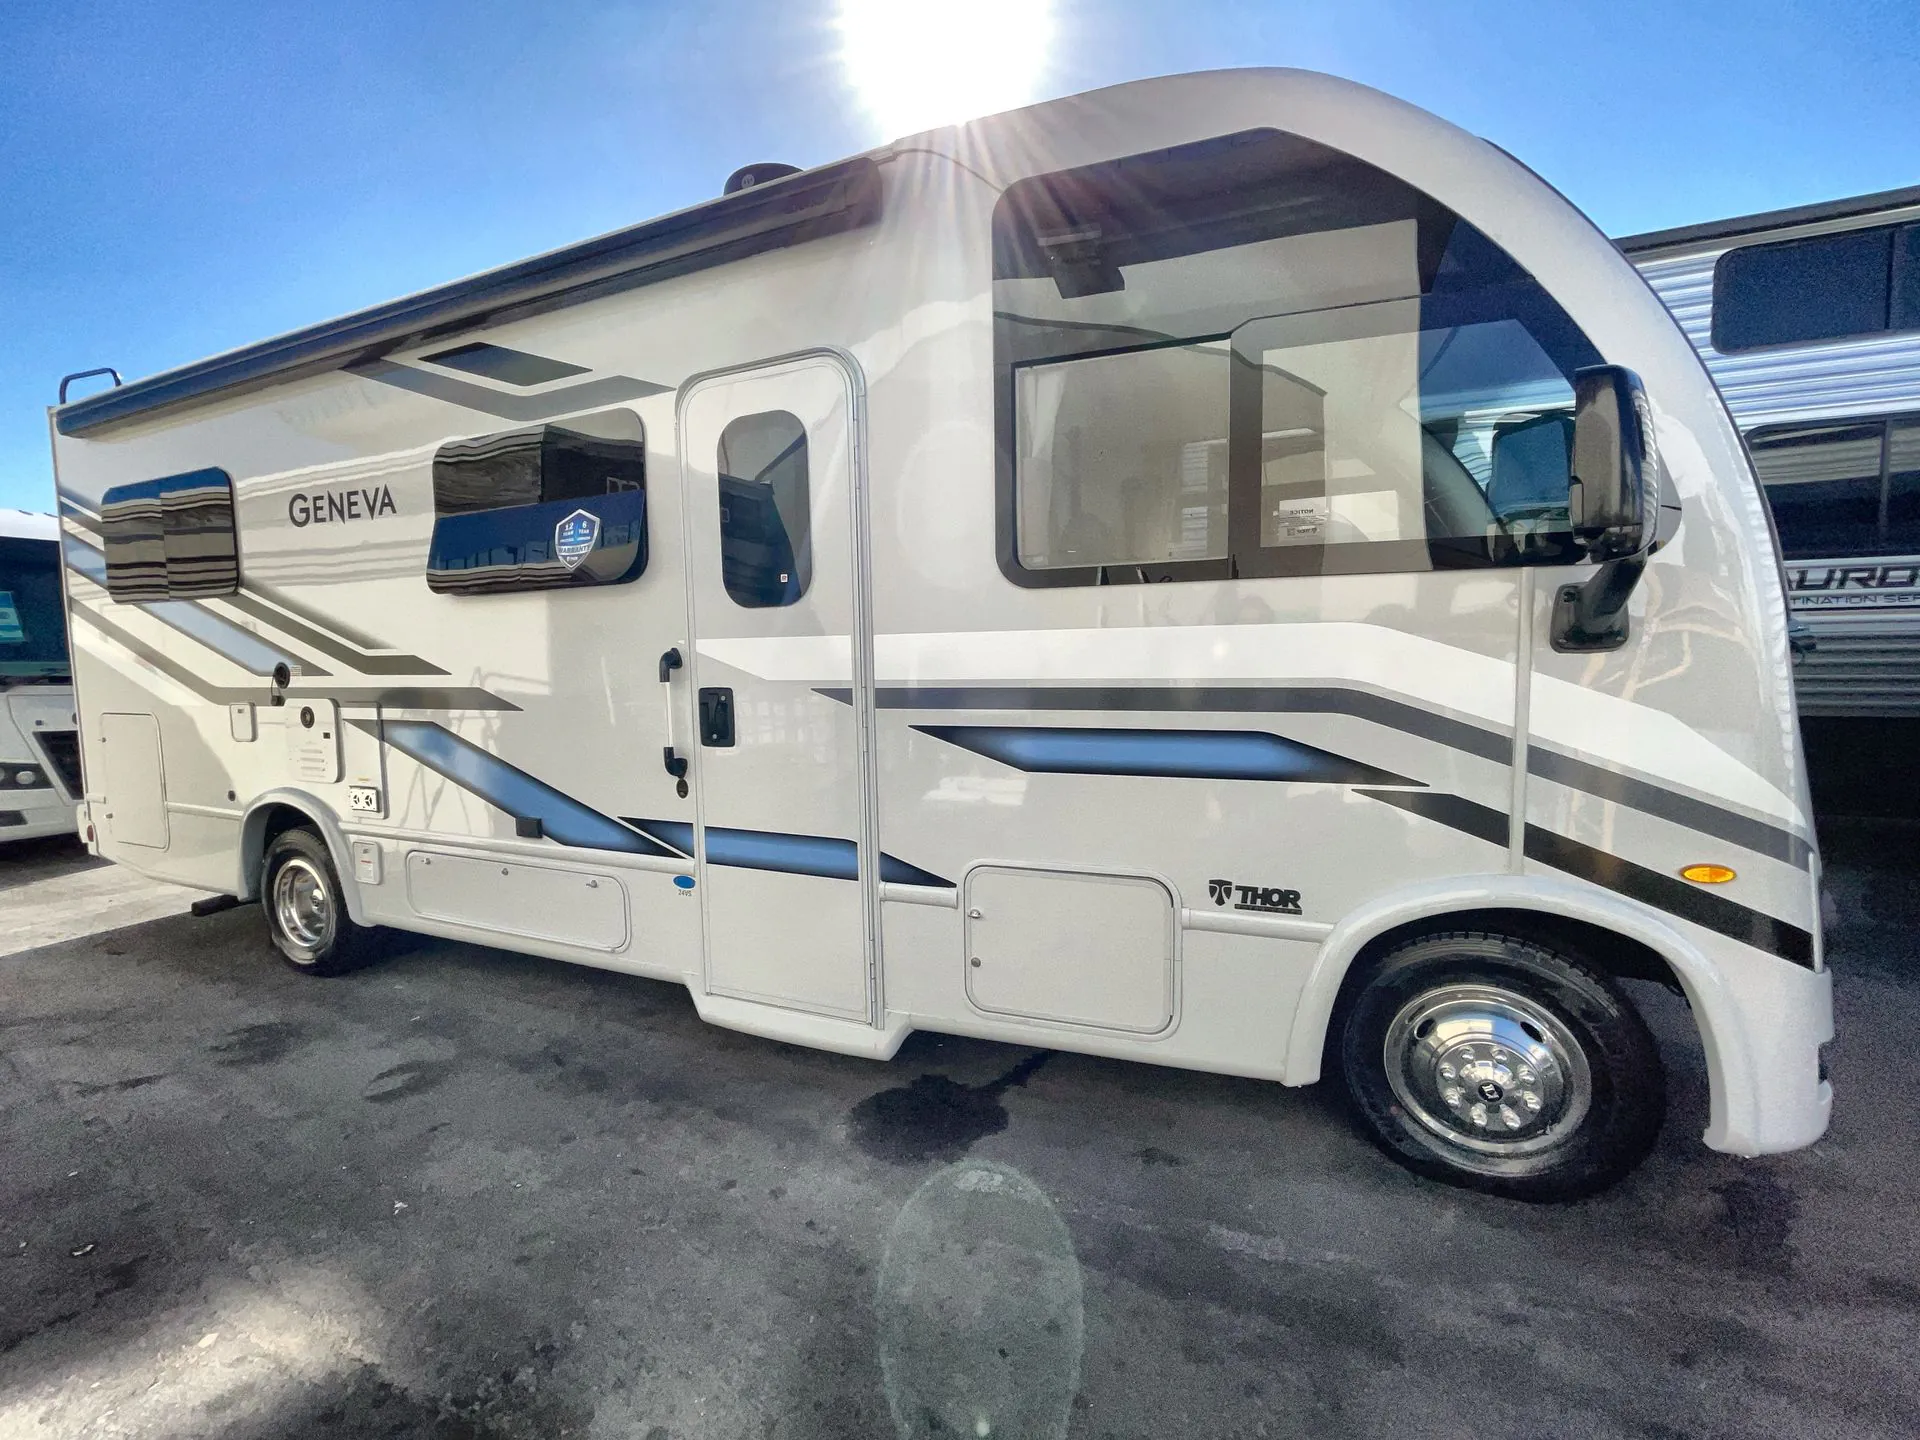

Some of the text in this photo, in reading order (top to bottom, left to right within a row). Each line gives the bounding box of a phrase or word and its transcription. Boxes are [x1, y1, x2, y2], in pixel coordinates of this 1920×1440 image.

[288, 484, 397, 527] GENEVA
[565, 522, 574, 531] 12
[582, 520, 588, 528] 6
[1791, 595, 1877, 605] TINATION
[1234, 885, 1302, 909] THOR
